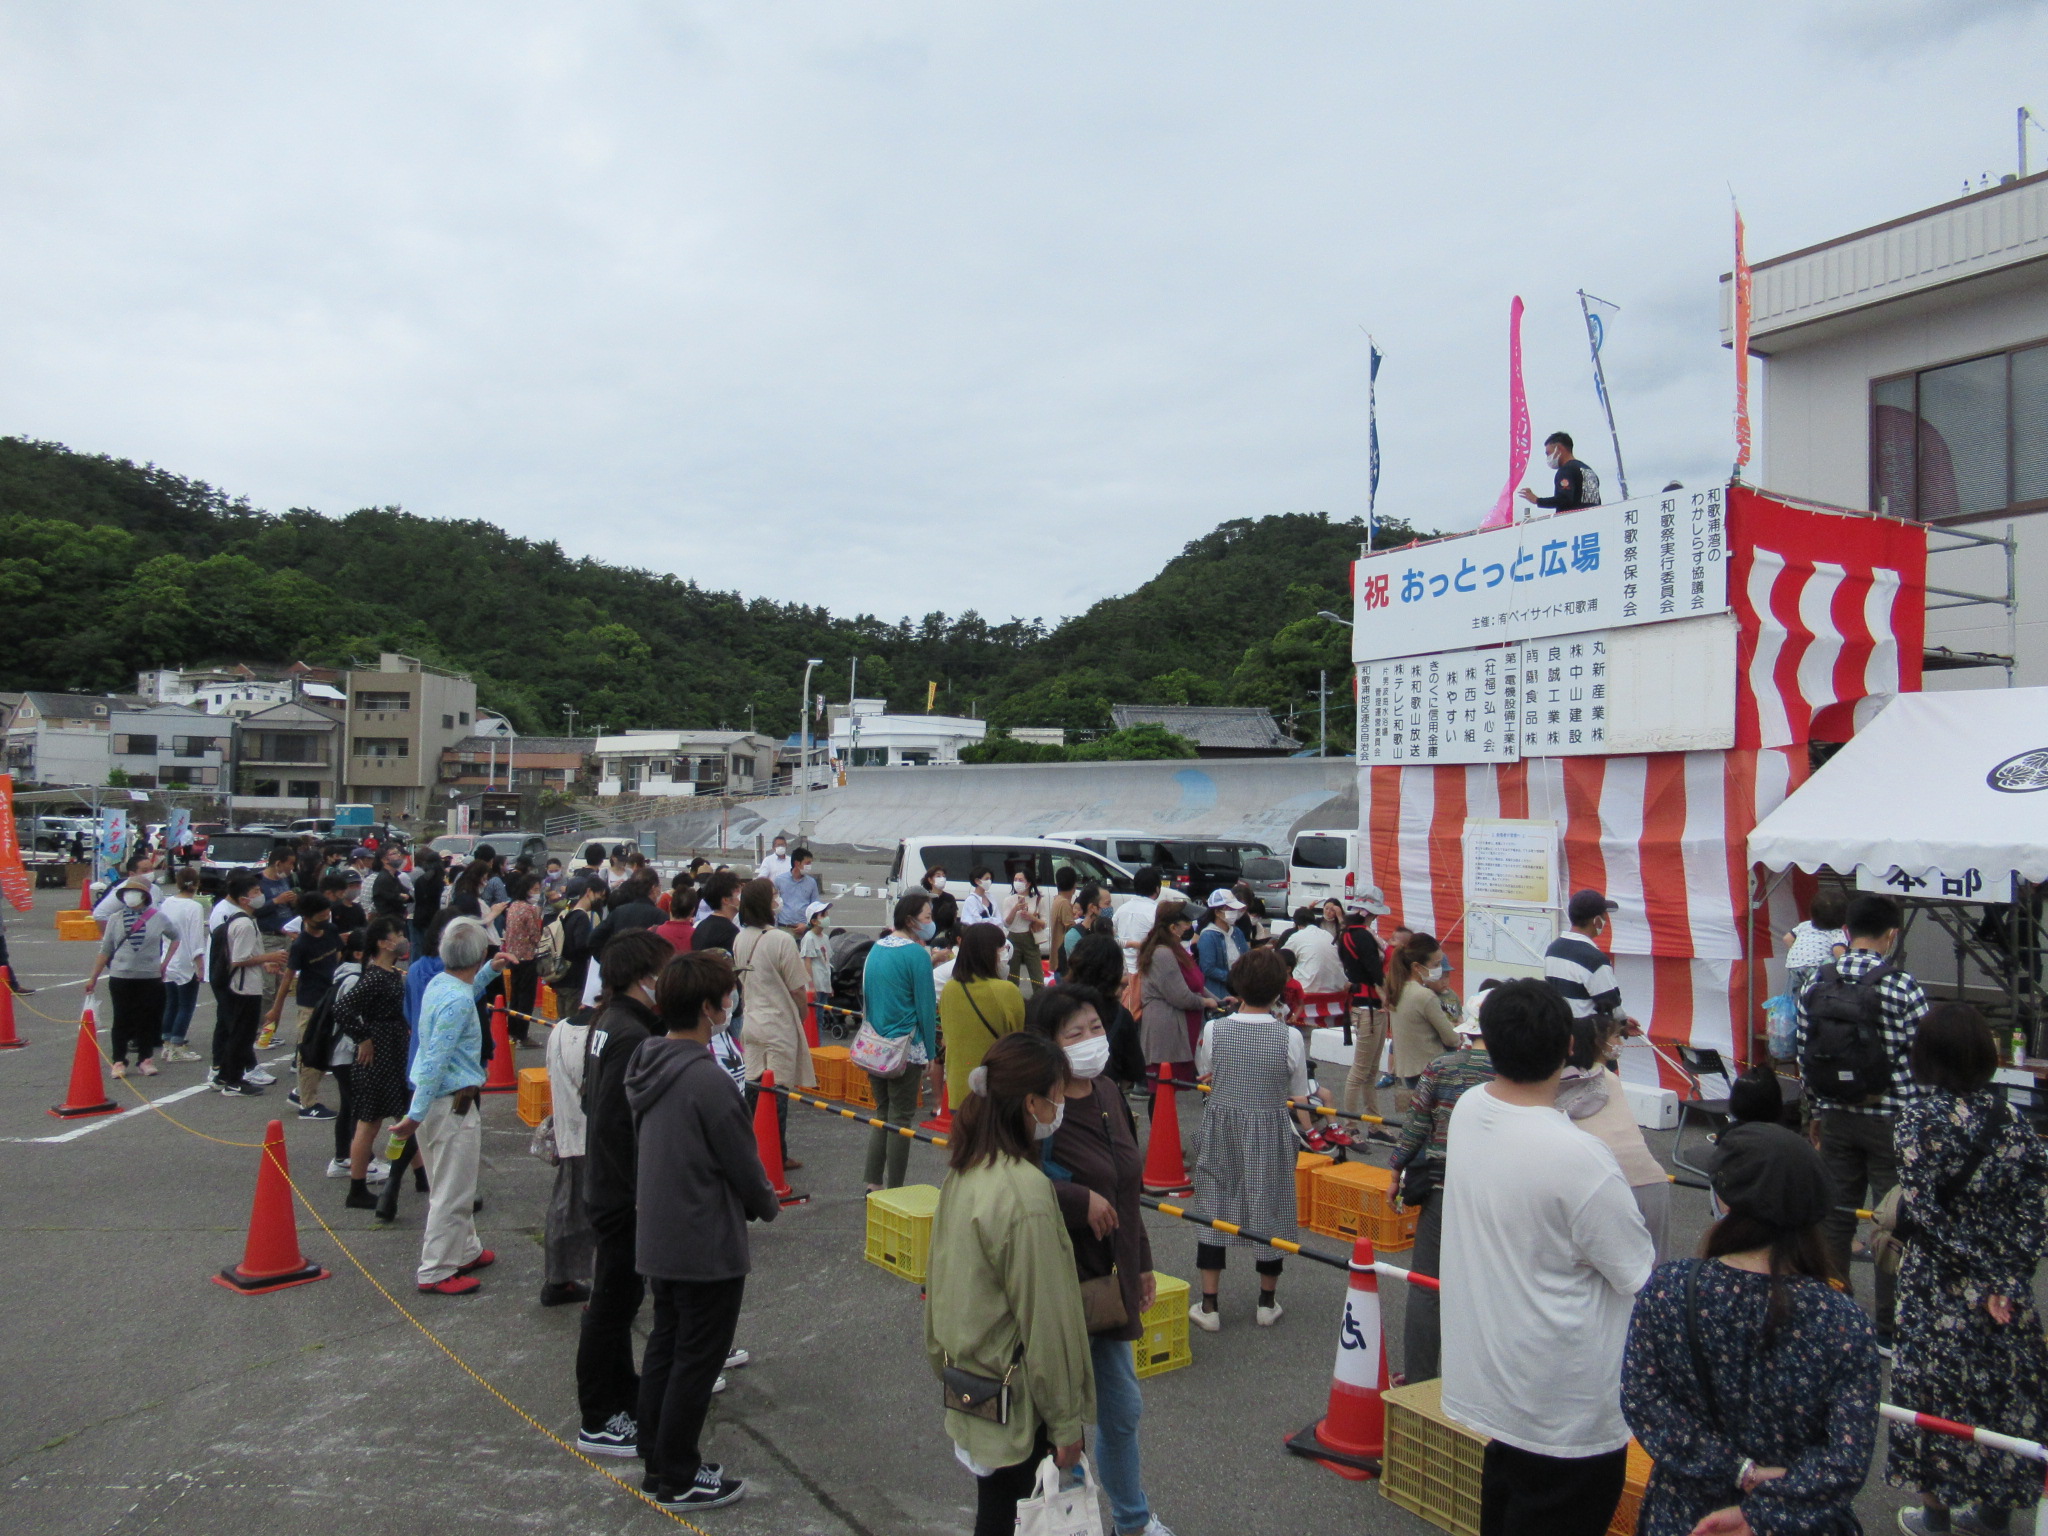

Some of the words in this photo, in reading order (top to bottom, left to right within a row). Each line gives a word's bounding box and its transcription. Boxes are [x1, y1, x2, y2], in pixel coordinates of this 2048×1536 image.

[1364, 574, 1389, 611] 祝
[1400, 532, 1600, 603] おっとっと広場
[1623, 510, 1638, 617] 和歌祭保存会
[1660, 499, 1675, 614] 和歌祭実行委員会
[1691, 493, 1704, 610] わかしらす協議会
[1707, 488, 1721, 561] 和歌浦湾の
[1360, 665, 1371, 761] 和歌浦地区連合自治会
[1428, 661, 1439, 758] きのくに信用金庫
